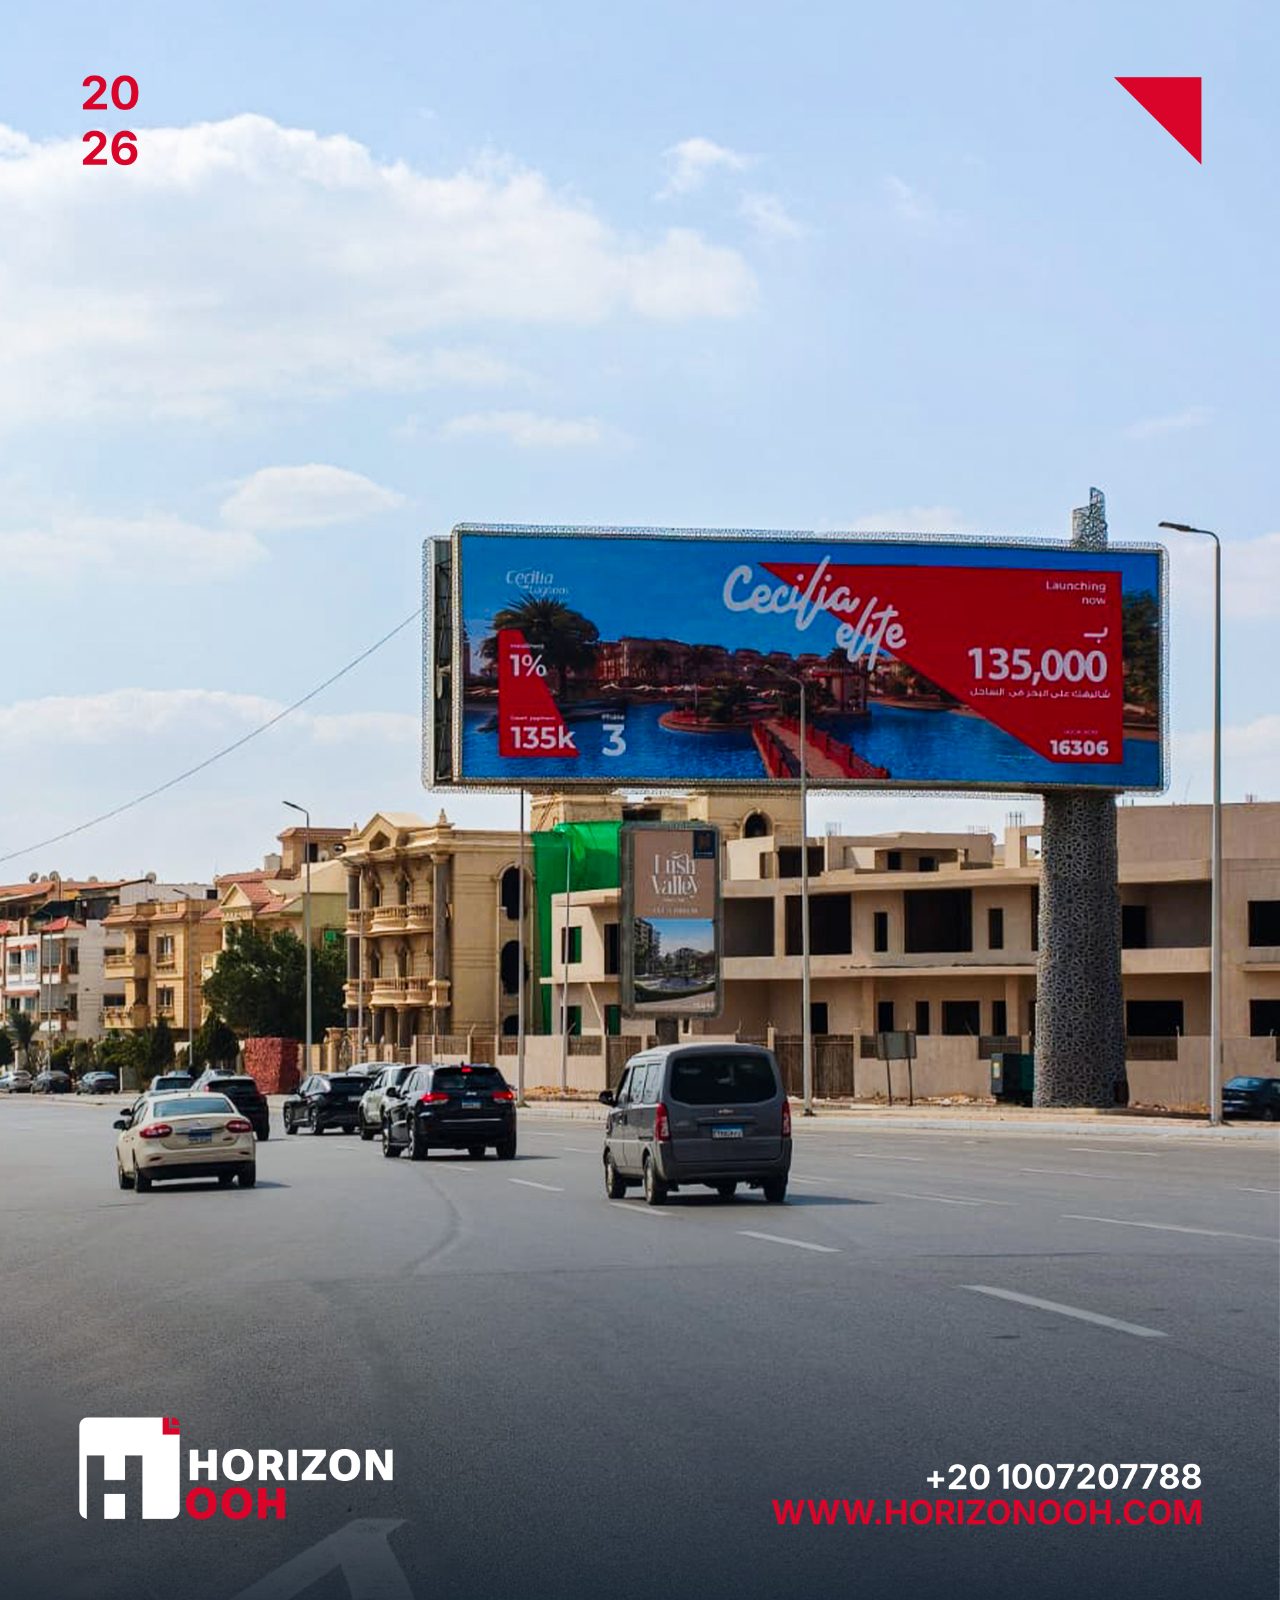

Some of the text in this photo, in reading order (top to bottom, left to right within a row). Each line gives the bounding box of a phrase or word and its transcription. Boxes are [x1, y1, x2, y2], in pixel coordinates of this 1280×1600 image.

[506, 568, 554, 588] Cecilia
[1046, 581, 1107, 593] Launching
[723, 555, 860, 631] Cecilia
[1082, 597, 1106, 605] now
[836, 596, 907, 672] elite
[509, 654, 547, 677] 1%
[968, 648, 1108, 686] 135,000
[509, 725, 576, 749] 135k
[602, 724, 627, 757] 3
[1050, 740, 1109, 756] 16306
[652, 875, 698, 899] Valley
